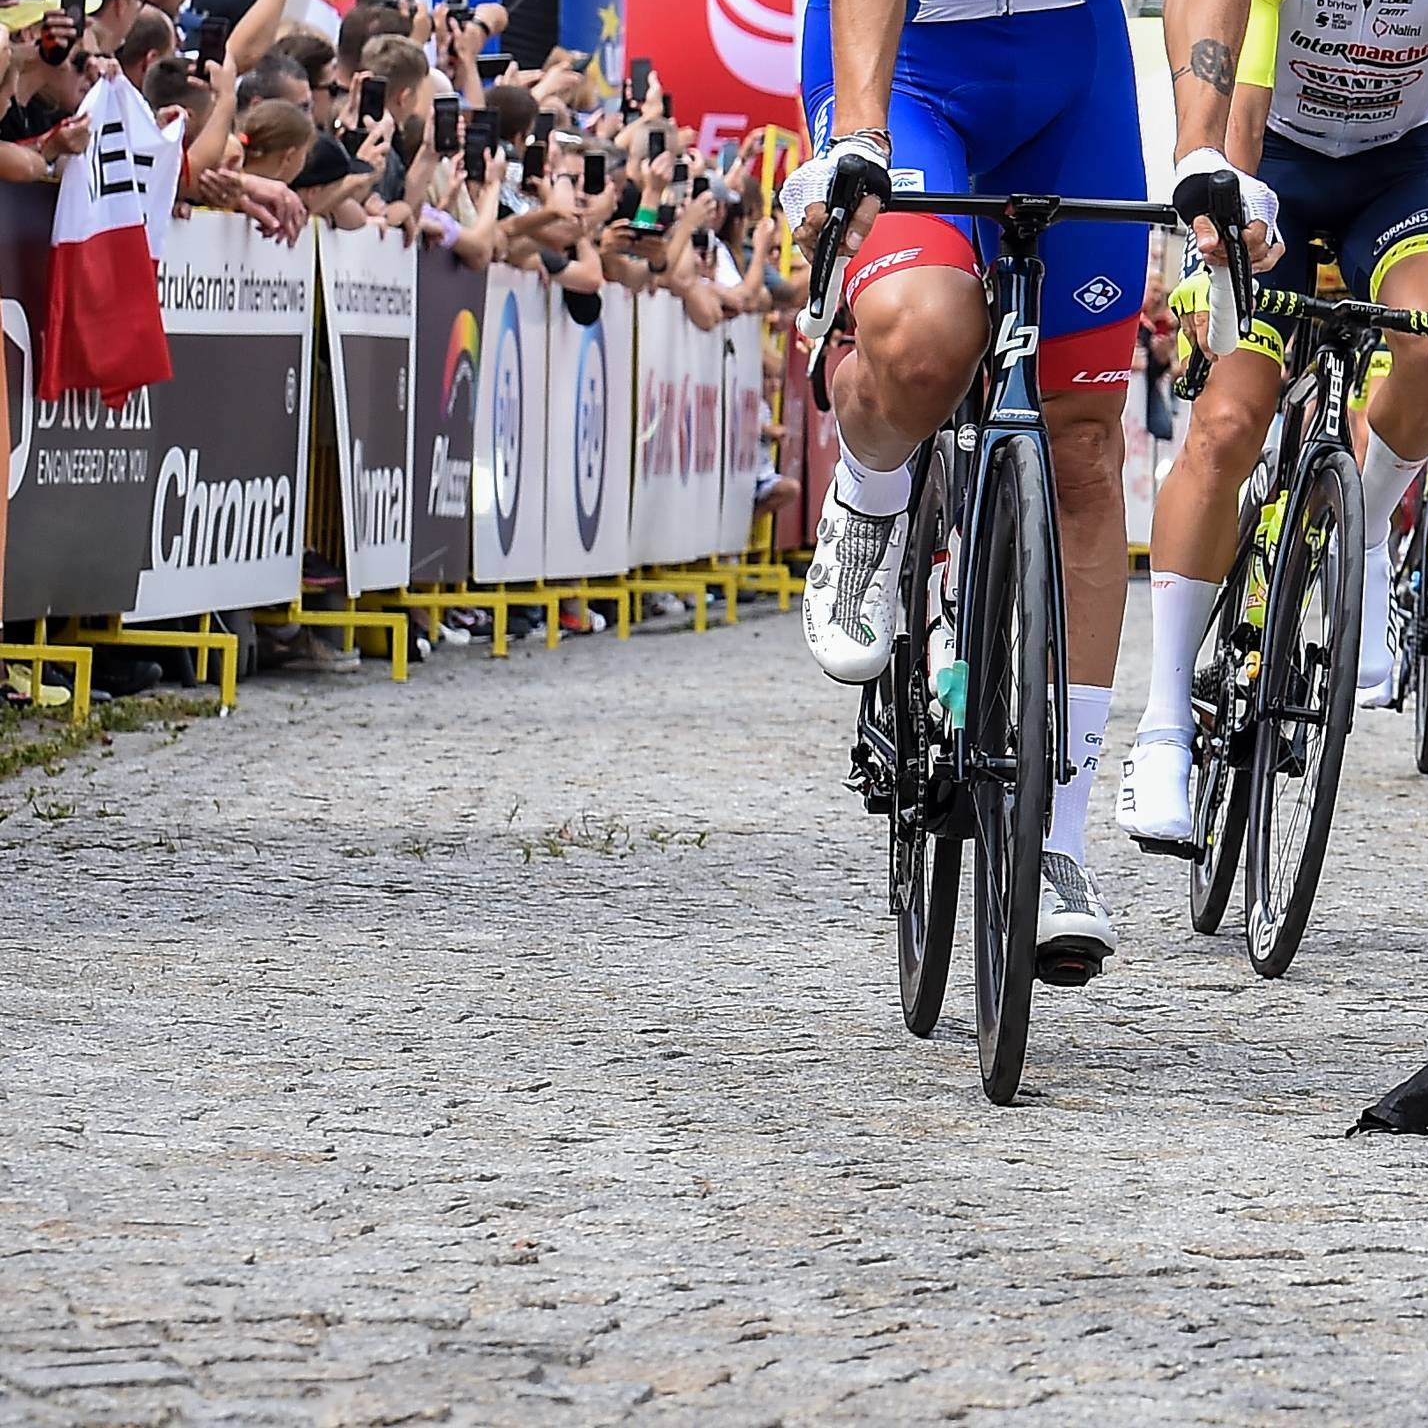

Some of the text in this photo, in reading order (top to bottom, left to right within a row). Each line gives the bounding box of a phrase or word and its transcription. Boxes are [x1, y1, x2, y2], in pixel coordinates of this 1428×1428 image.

[1389, 23, 1422, 37] Nalini
[1305, 68, 1409, 90] WANTY
[1376, 211, 1428, 248] TORMANS
[157, 263, 236, 310] drukarnia
[1325, 352, 1345, 436] CUBE
[37, 447, 149, 485] ENGINEERED FOR YOU
[151, 445, 295, 570] Chroma
